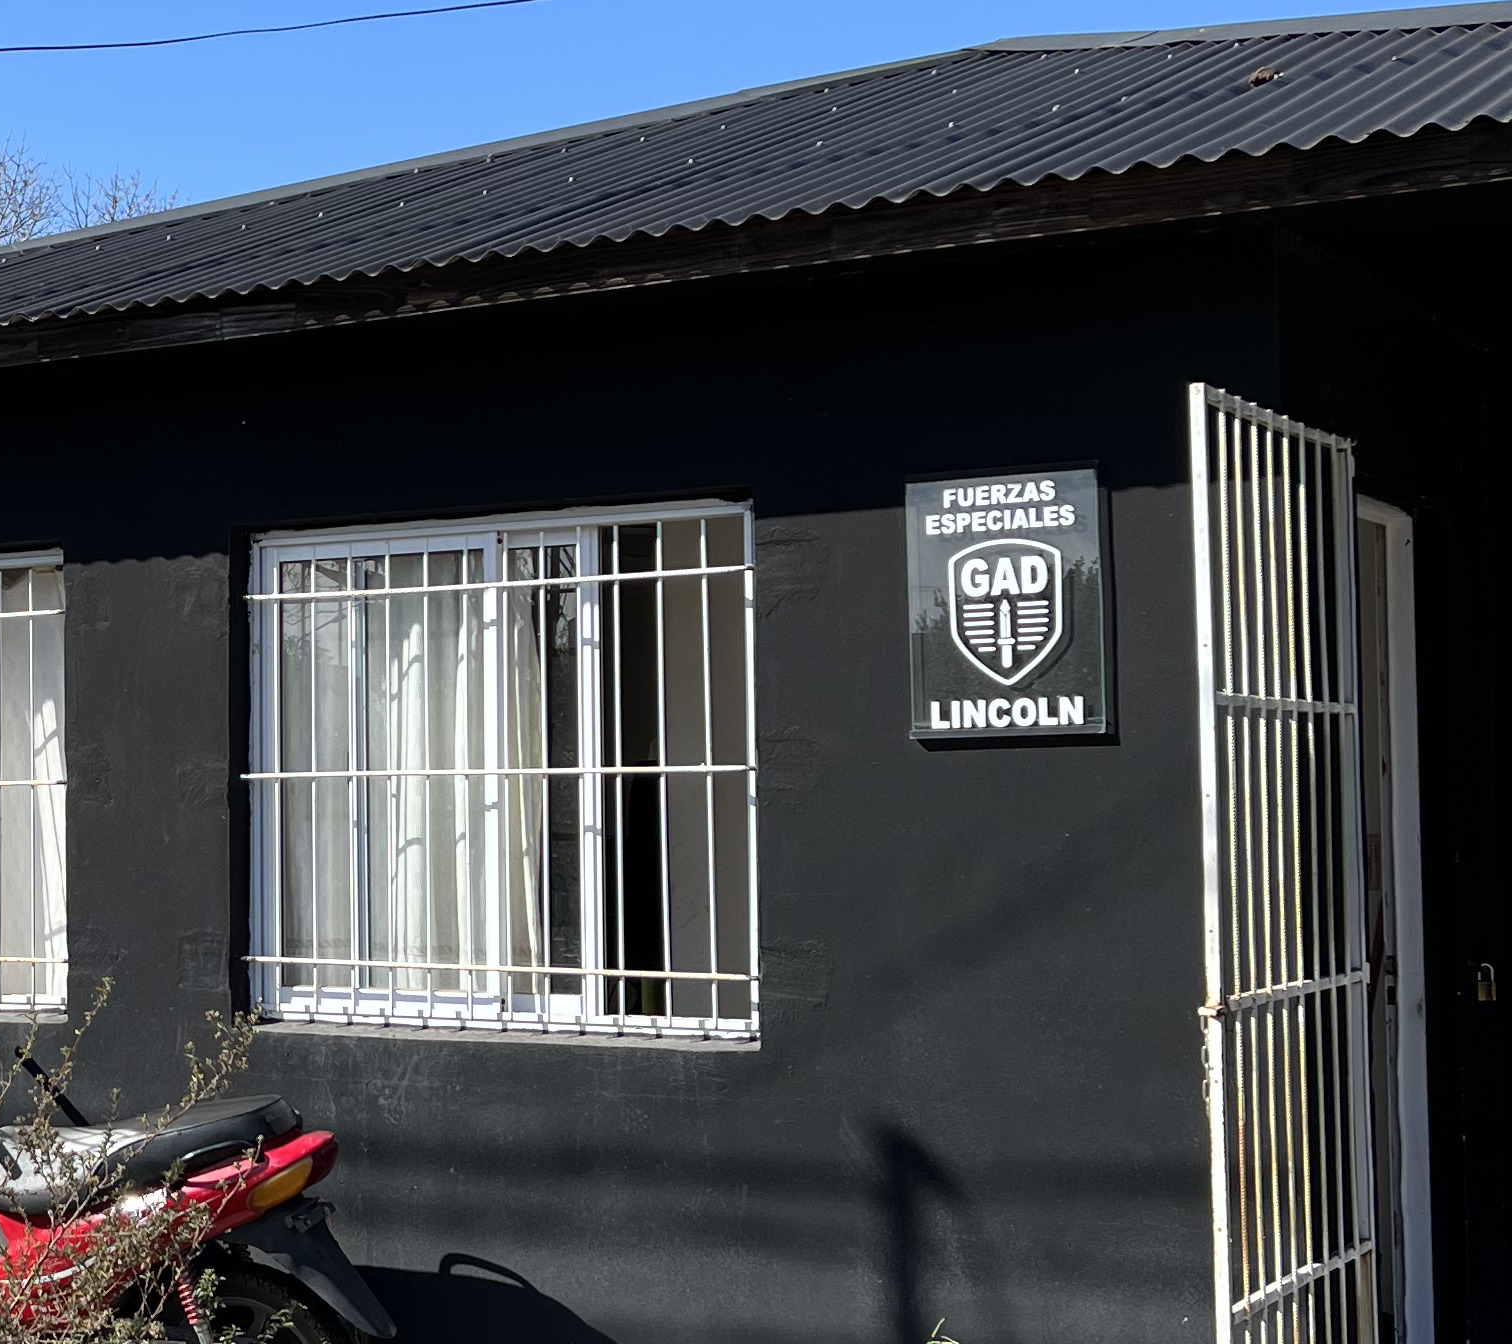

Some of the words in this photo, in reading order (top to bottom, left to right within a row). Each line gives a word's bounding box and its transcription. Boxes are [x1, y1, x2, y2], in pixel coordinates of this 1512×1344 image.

[943, 480, 1056, 508] FUERZAS
[925, 505, 1076, 535] ESPECIALES
[960, 555, 1048, 597] GAD
[930, 695, 1084, 730] LINCOLN
